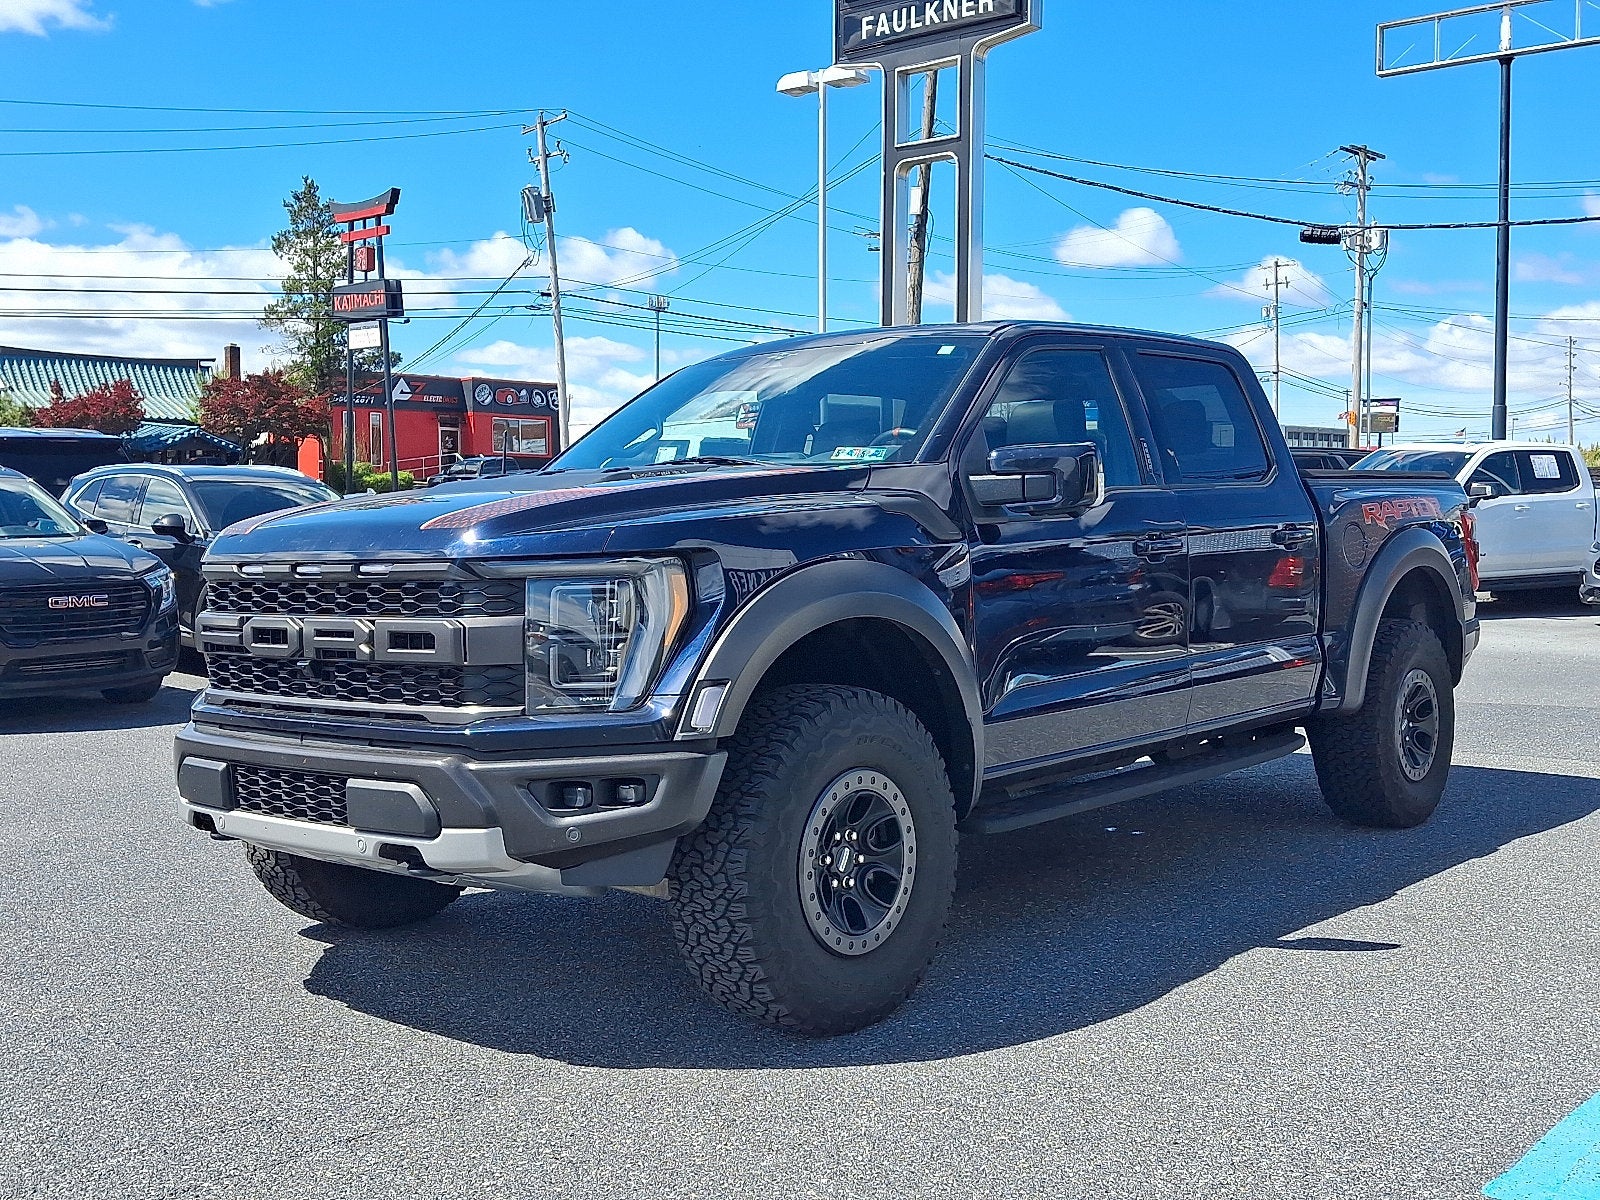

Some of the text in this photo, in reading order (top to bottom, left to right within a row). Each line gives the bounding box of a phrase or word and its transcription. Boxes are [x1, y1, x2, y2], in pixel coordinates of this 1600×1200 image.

[861, 0, 993, 39] FAULKNER
[334, 289, 384, 311] KAJIMACHI
[1362, 496, 1443, 531] RAPTOR
[49, 594, 109, 609] GMC
[197, 612, 464, 665] FORD
